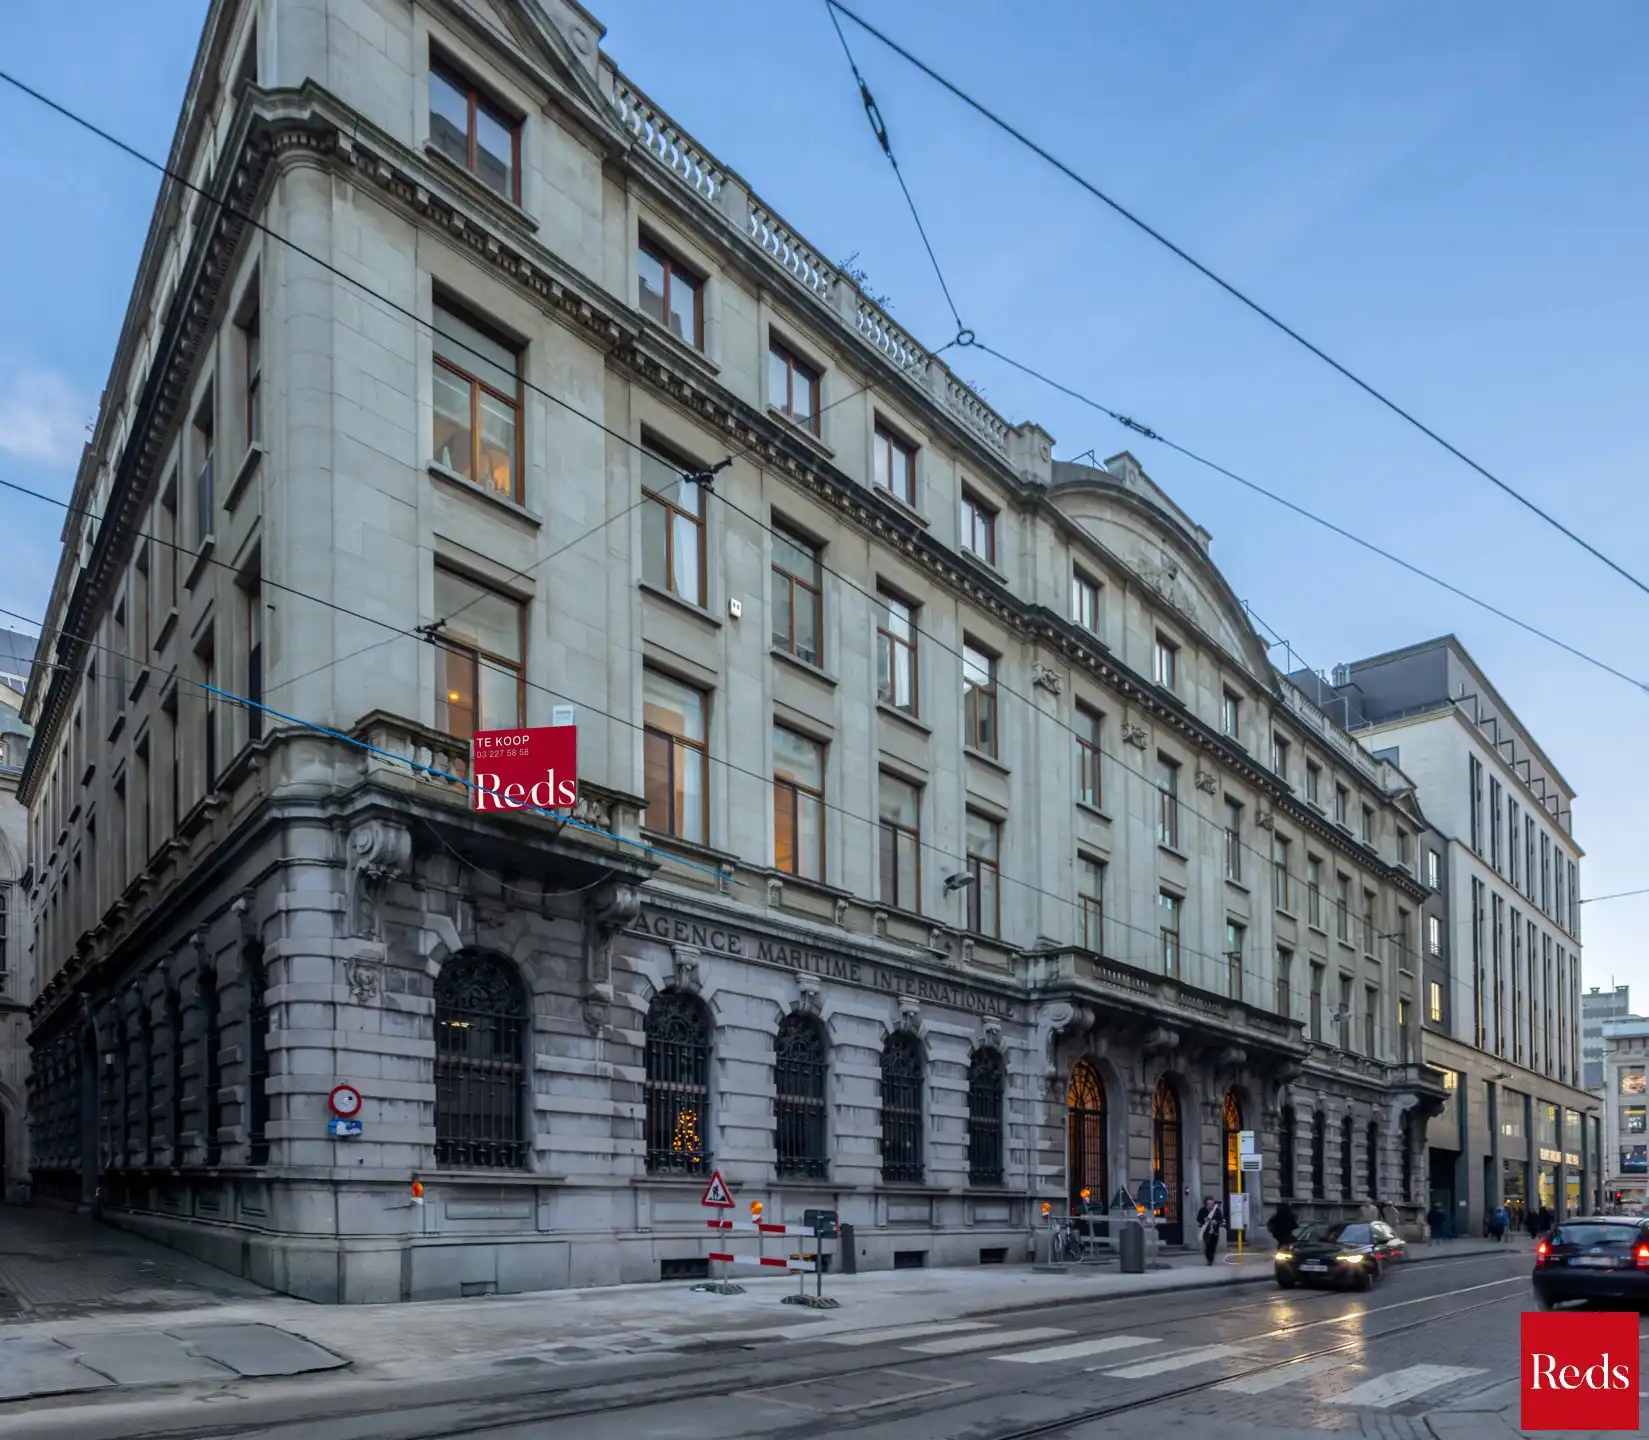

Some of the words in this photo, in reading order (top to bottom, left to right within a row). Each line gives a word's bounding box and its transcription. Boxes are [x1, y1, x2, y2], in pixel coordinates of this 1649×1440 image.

[476, 737, 492, 748] TE
[495, 735, 530, 747] KOOP
[476, 751, 487, 759] 03
[489, 749, 504, 758] 227
[506, 749, 517, 757] 58
[519, 748, 530, 756] 58
[475, 768, 576, 810] Reds
[633, 911, 742, 955] AGENCE
[756, 940, 862, 982] MARITIME
[873, 964, 1015, 1018] INTERNATIONALE
